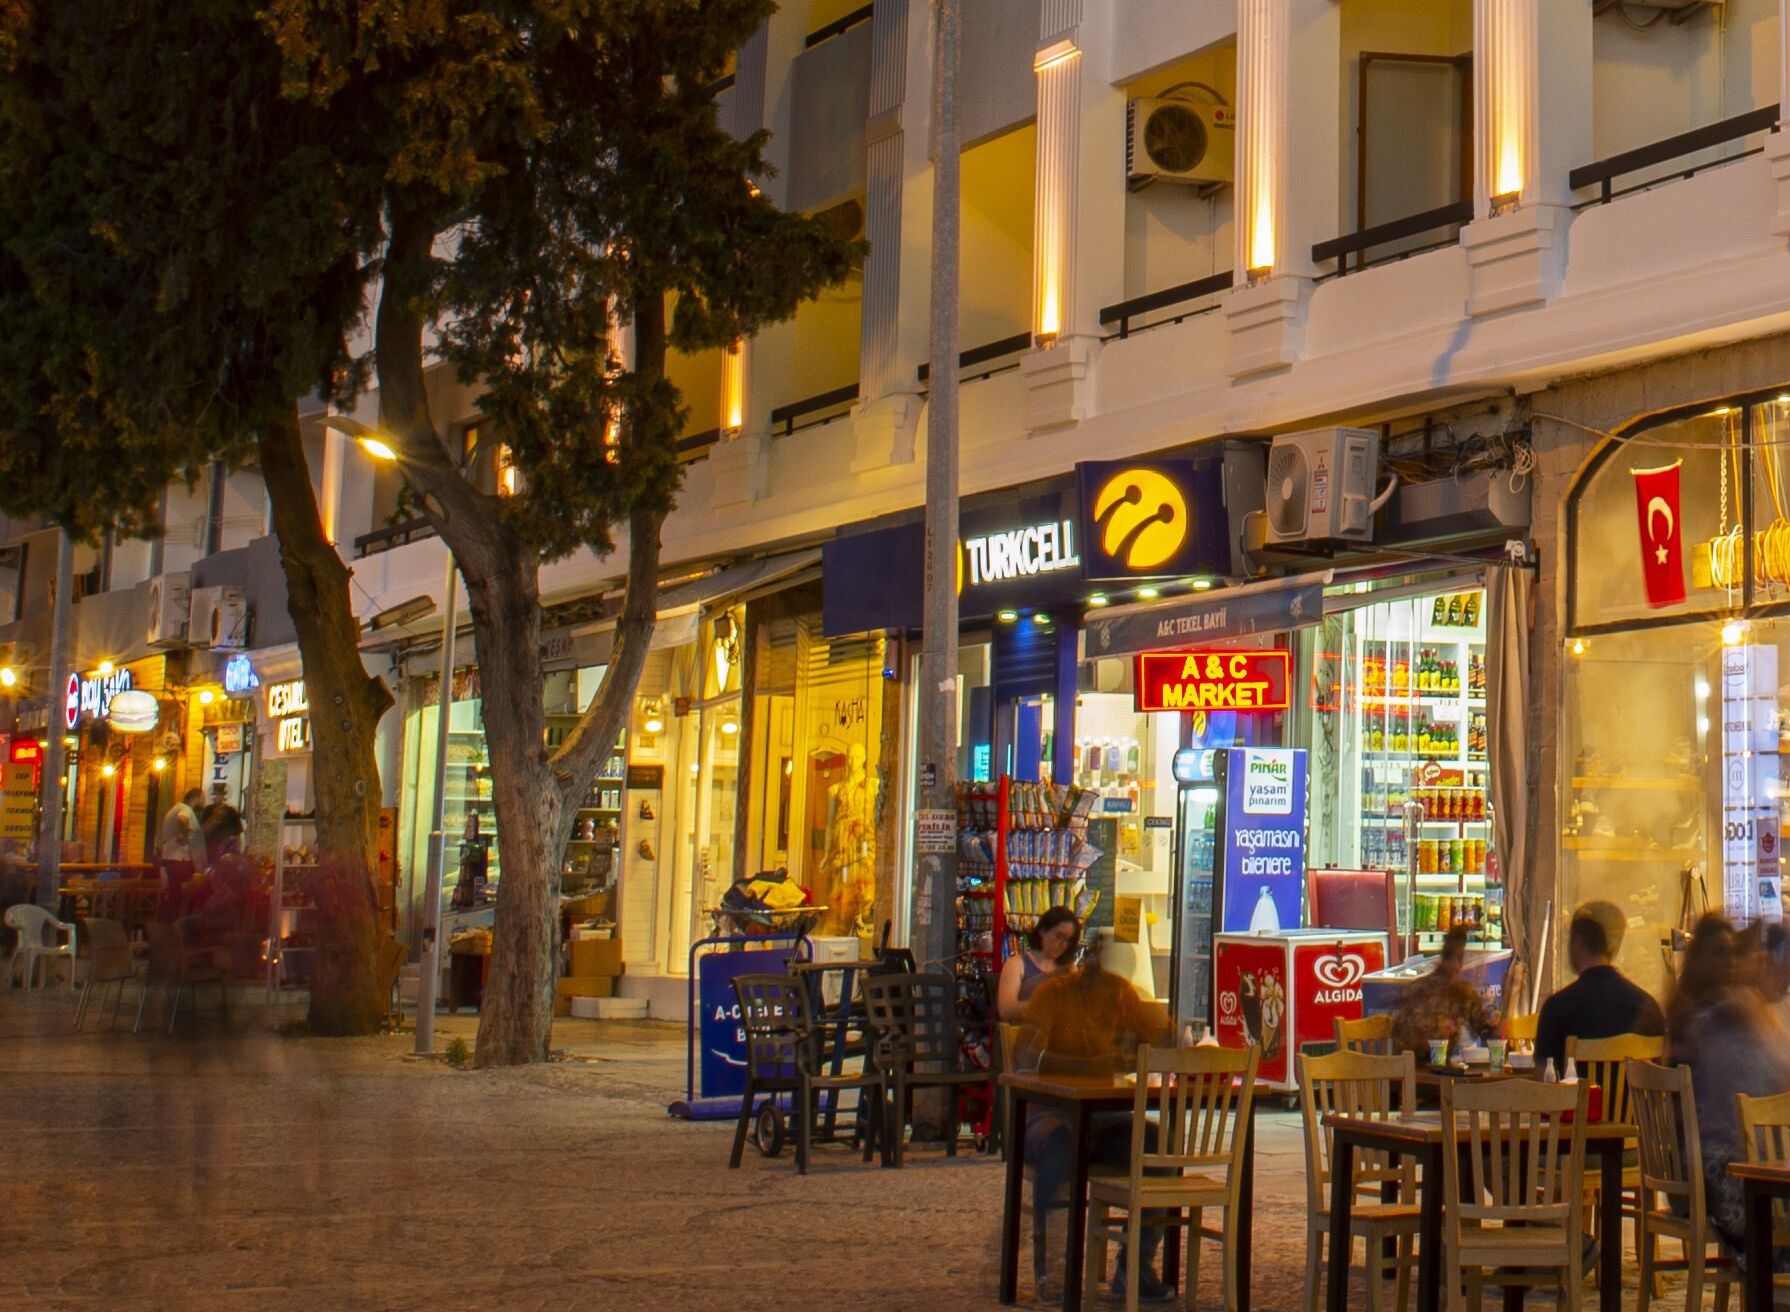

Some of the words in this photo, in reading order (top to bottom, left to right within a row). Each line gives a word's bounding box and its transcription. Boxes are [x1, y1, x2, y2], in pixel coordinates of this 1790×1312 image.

[965, 519, 1080, 585] TURKCELL
[1177, 613, 1202, 634] TEKEL
[1181, 655, 1200, 680] A
[1205, 655, 1225, 679] &
[1229, 655, 1248, 679] C
[1162, 682, 1269, 708] MARKET
